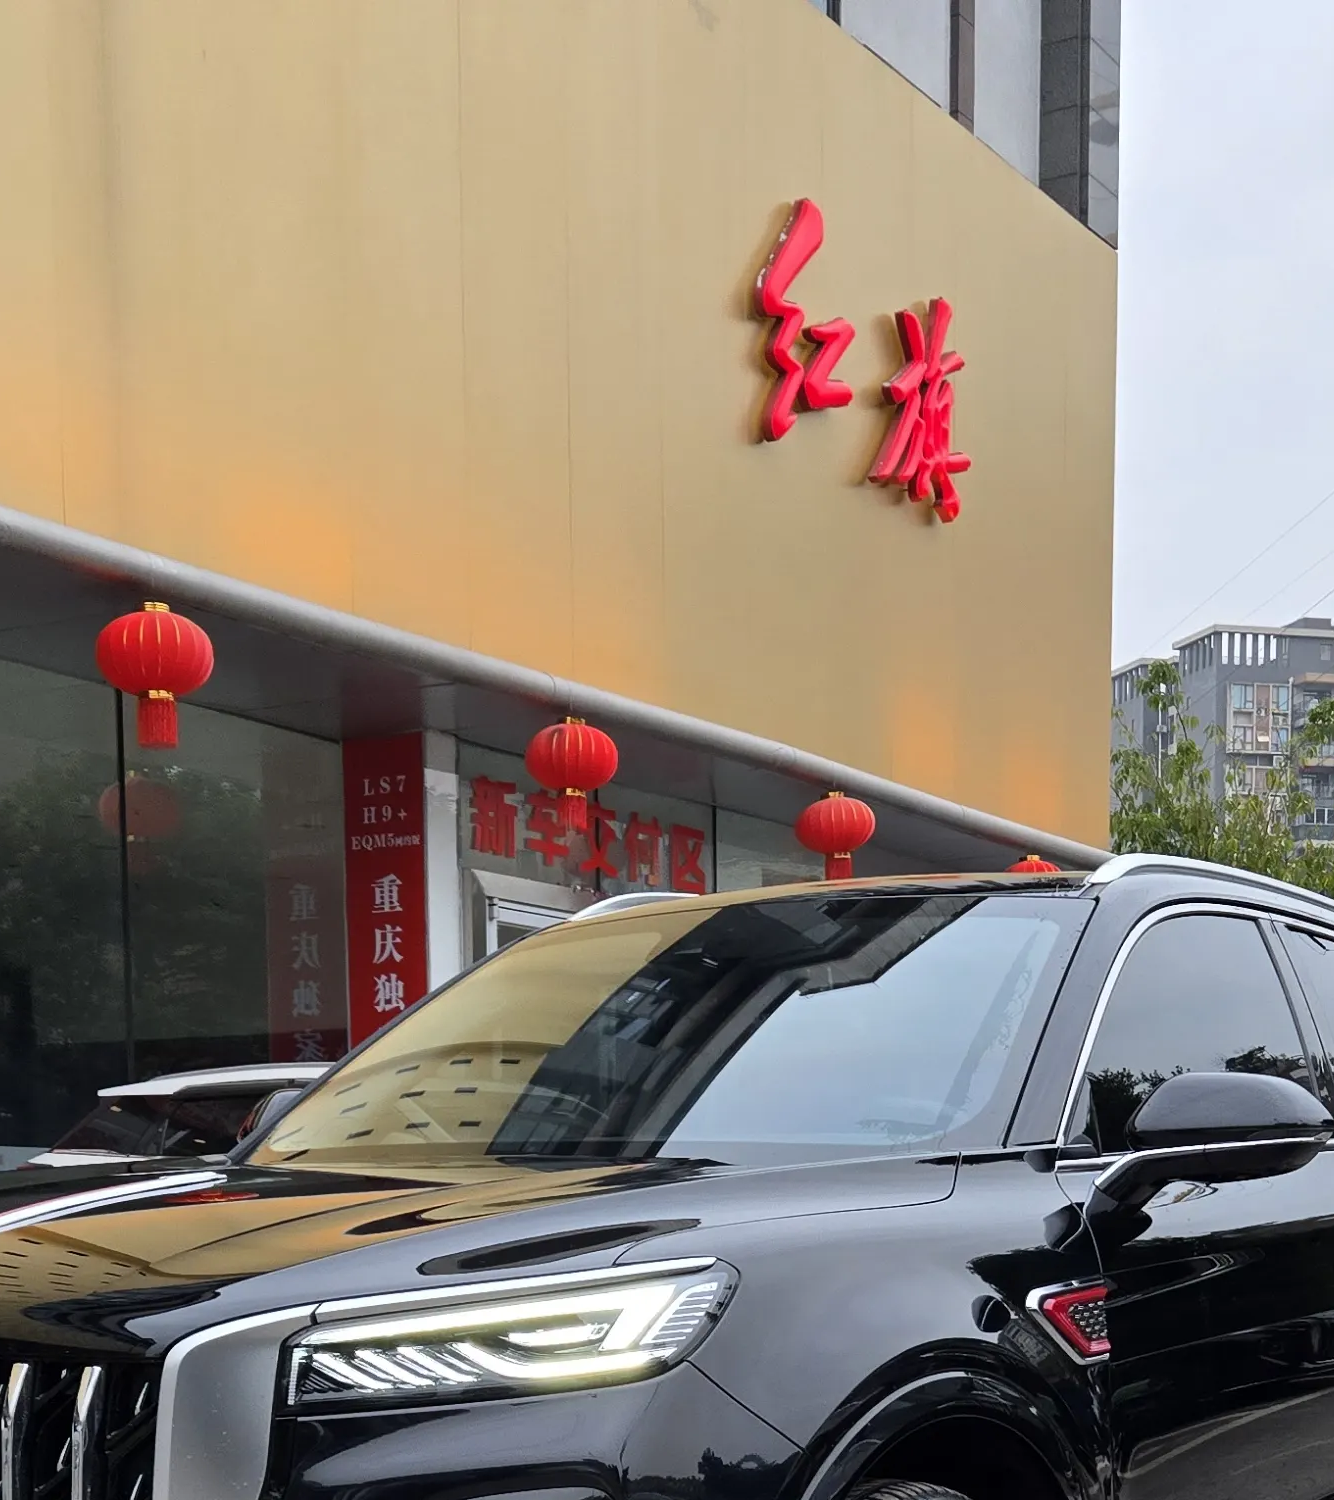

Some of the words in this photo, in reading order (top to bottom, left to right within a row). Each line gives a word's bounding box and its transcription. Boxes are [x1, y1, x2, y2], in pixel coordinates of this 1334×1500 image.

[754, 197, 972, 524] 红旗
[362, 805, 408, 824] H9+
[370, 873, 406, 1014] 重庆独
